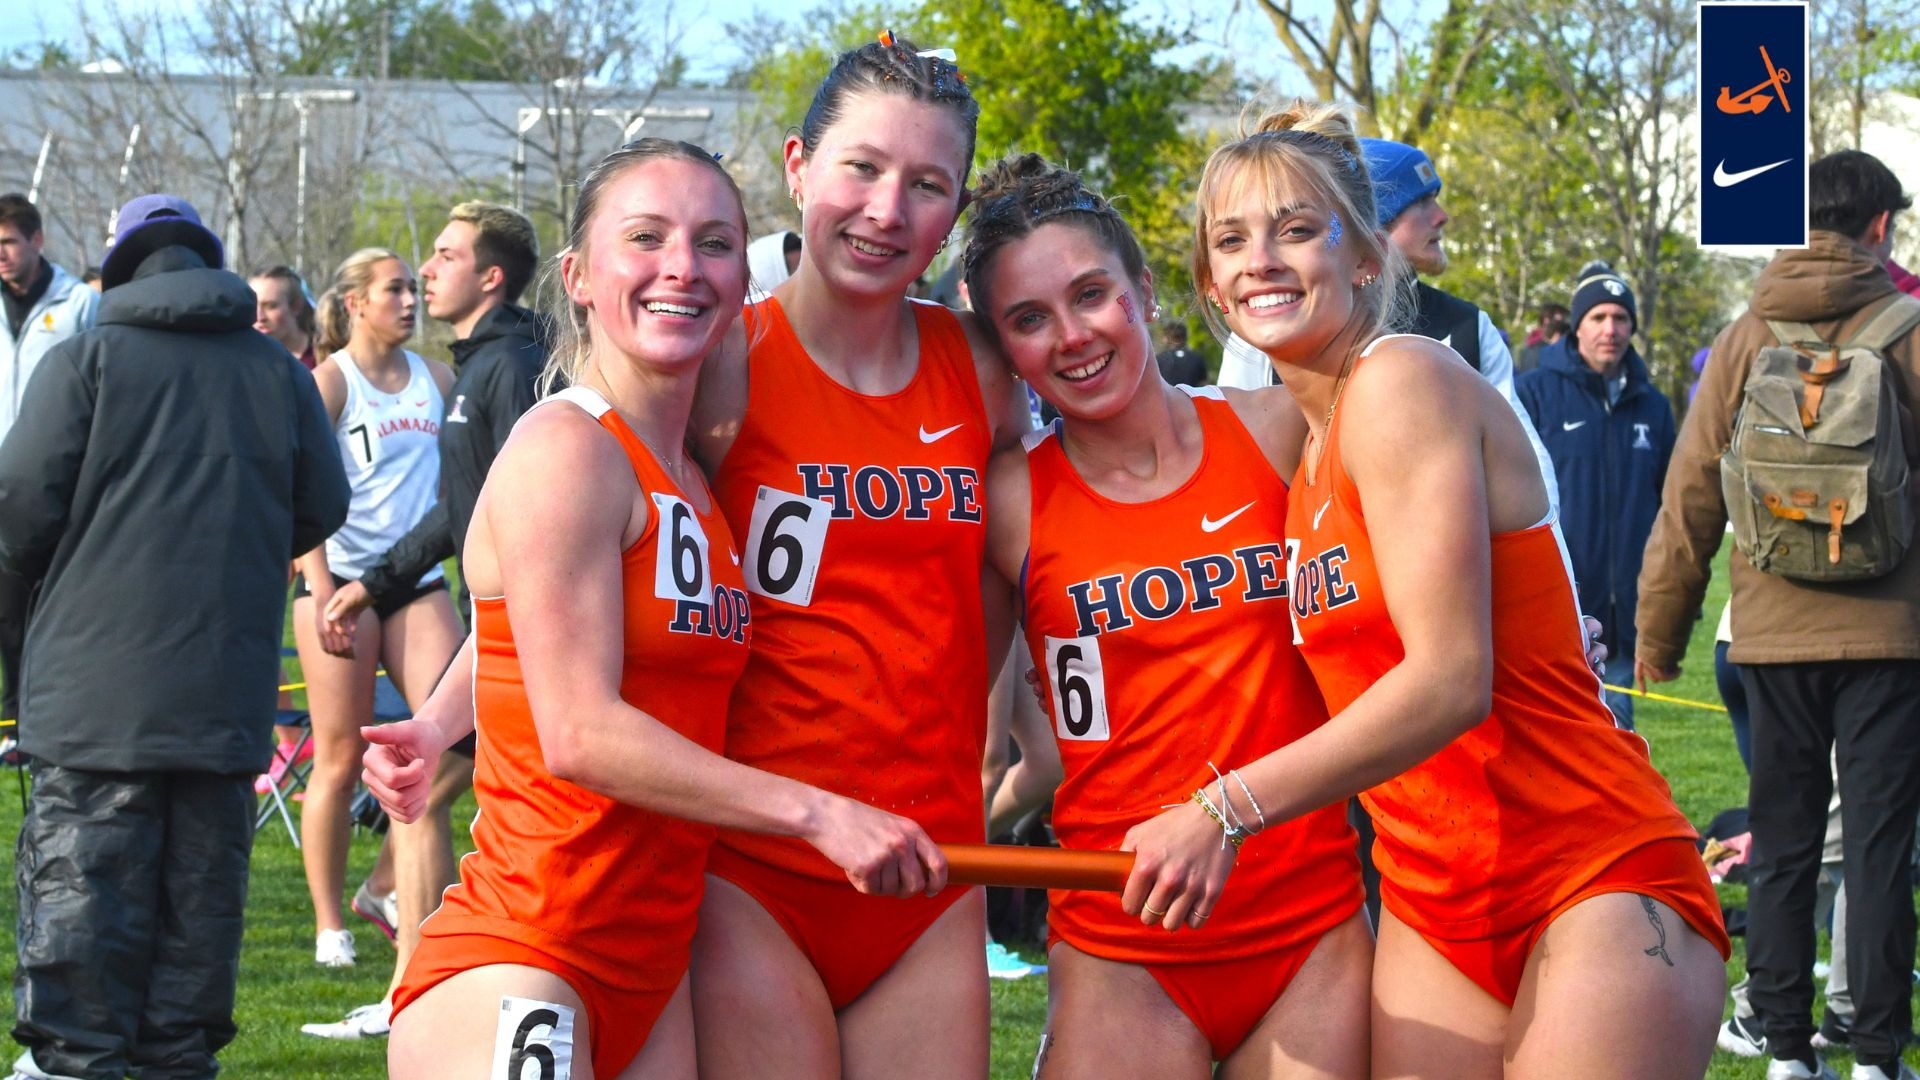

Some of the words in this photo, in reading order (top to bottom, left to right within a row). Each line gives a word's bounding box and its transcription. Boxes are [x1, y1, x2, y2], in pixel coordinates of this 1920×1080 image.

[348, 423, 372, 463] 7
[797, 463, 982, 525] HOPE
[671, 502, 703, 597] 6
[757, 500, 812, 595] 6
[1291, 543, 1359, 619] OPE
[668, 583, 752, 649] HOP
[1066, 543, 1290, 639] HOPE
[1056, 644, 1093, 737] 6
[508, 1008, 560, 1080] 6
